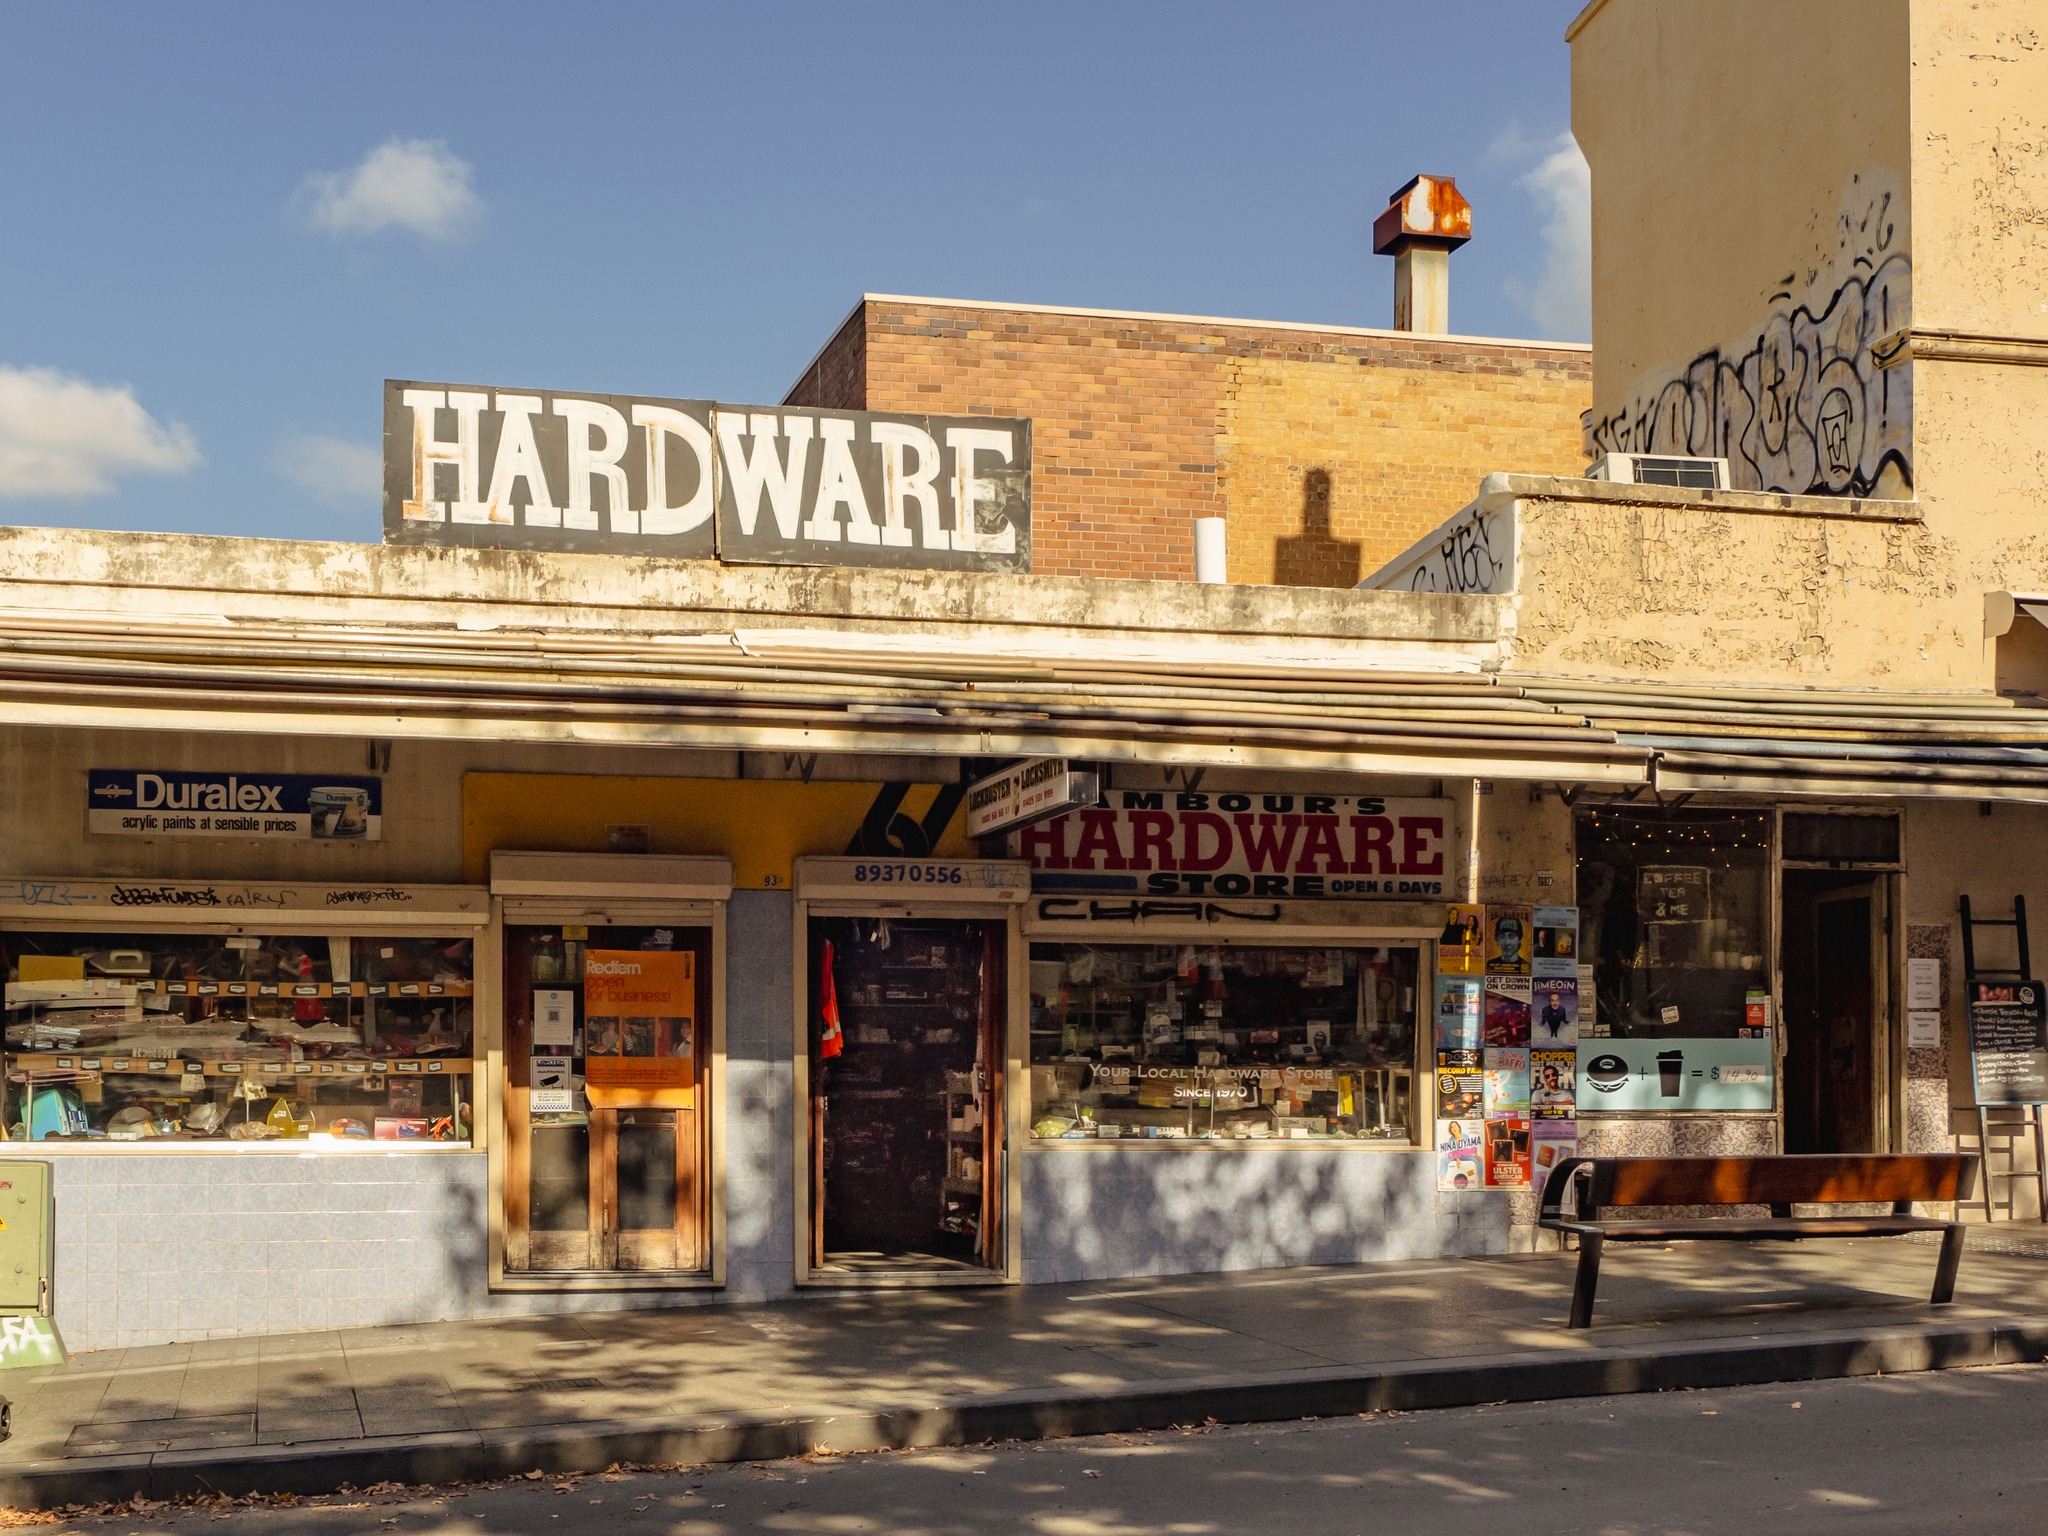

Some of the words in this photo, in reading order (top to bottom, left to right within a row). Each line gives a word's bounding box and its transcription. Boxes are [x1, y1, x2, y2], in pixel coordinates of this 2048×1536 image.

[402, 389, 1016, 554] HARDWARE
[136, 773, 283, 812] Duralex
[969, 777, 1011, 812] LOCKBUSTER
[1021, 758, 1064, 790] LOCKSMITH
[326, 793, 354, 802] Duralex
[122, 814, 158, 831] acrylic
[163, 815, 196, 831] paints
[200, 817, 211, 830] at
[216, 817, 259, 831] sensible
[264, 817, 297, 832] prices
[1020, 810, 1444, 876] HARDWARE
[854, 864, 962, 884] 89370556
[1643, 871, 1702, 885] COFFEE
[1147, 872, 1325, 897] STORE
[1331, 879, 1378, 894] OPEN
[1383, 881, 1394, 894] 6
[1398, 881, 1442, 895] DAYS
[1659, 887, 1686, 899] TEA
[1670, 903, 1689, 916] ME
[585, 959, 642, 975] Redfern
[585, 976, 625, 991] open
[585, 987, 604, 1002] for
[608, 988, 672, 1003] business!
[1530, 1051, 1576, 1062] CHOPPER
[1438, 1067, 1466, 1075] RECORD
[1723, 1069, 1759, 1082] 14.90
[1440, 1140, 1457, 1153] NINA
[1458, 1136, 1482, 1149] OYAMA
[1493, 1166, 1523, 1175] ULSTER
